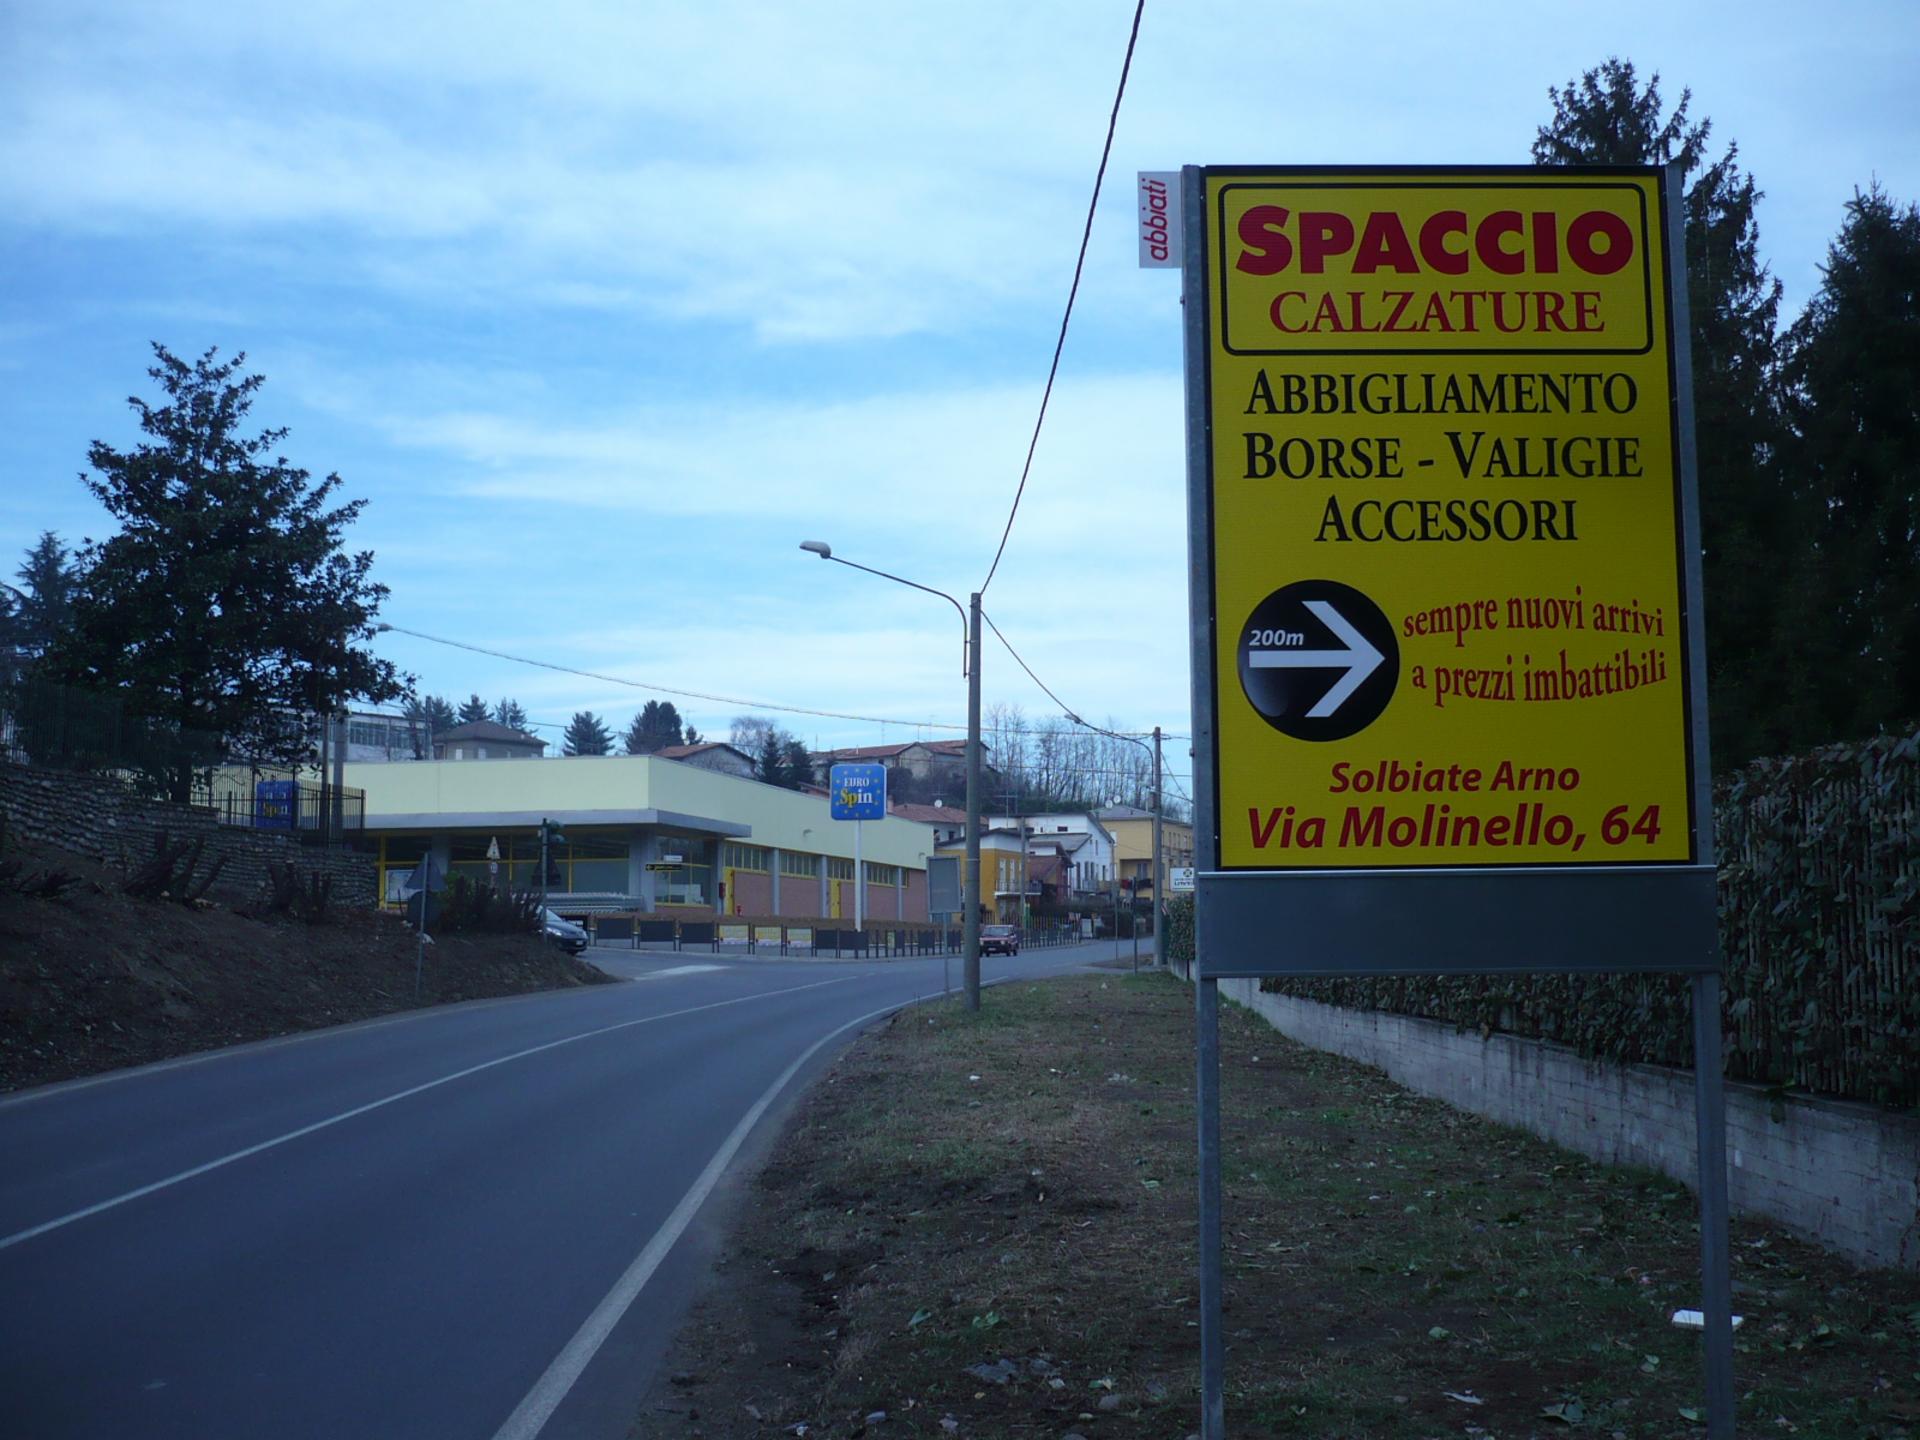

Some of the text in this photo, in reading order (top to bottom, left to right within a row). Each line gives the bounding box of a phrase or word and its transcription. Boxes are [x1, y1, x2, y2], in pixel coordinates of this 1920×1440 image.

[1142, 178, 1168, 261] abbiati
[1235, 205, 1634, 276] SPACCIO
[1269, 291, 1605, 333] CALZATURE
[1243, 368, 1638, 415] ABBIGLIAMENTO
[1242, 432, 1404, 480] BORSE
[1444, 431, 1644, 479] VALIGIE
[1313, 495, 1579, 543] ACCESSORI
[1248, 629, 1304, 647] 200m
[1403, 585, 1665, 647] sempre nuovi arrivi
[1412, 648, 1668, 708] a prezzi imbattibili
[840, 788, 873, 808] Spin
[844, 777, 870, 787] EURO
[1329, 761, 1580, 793] Solbiate Arno
[1247, 803, 1661, 852] Via Molinello, 64
